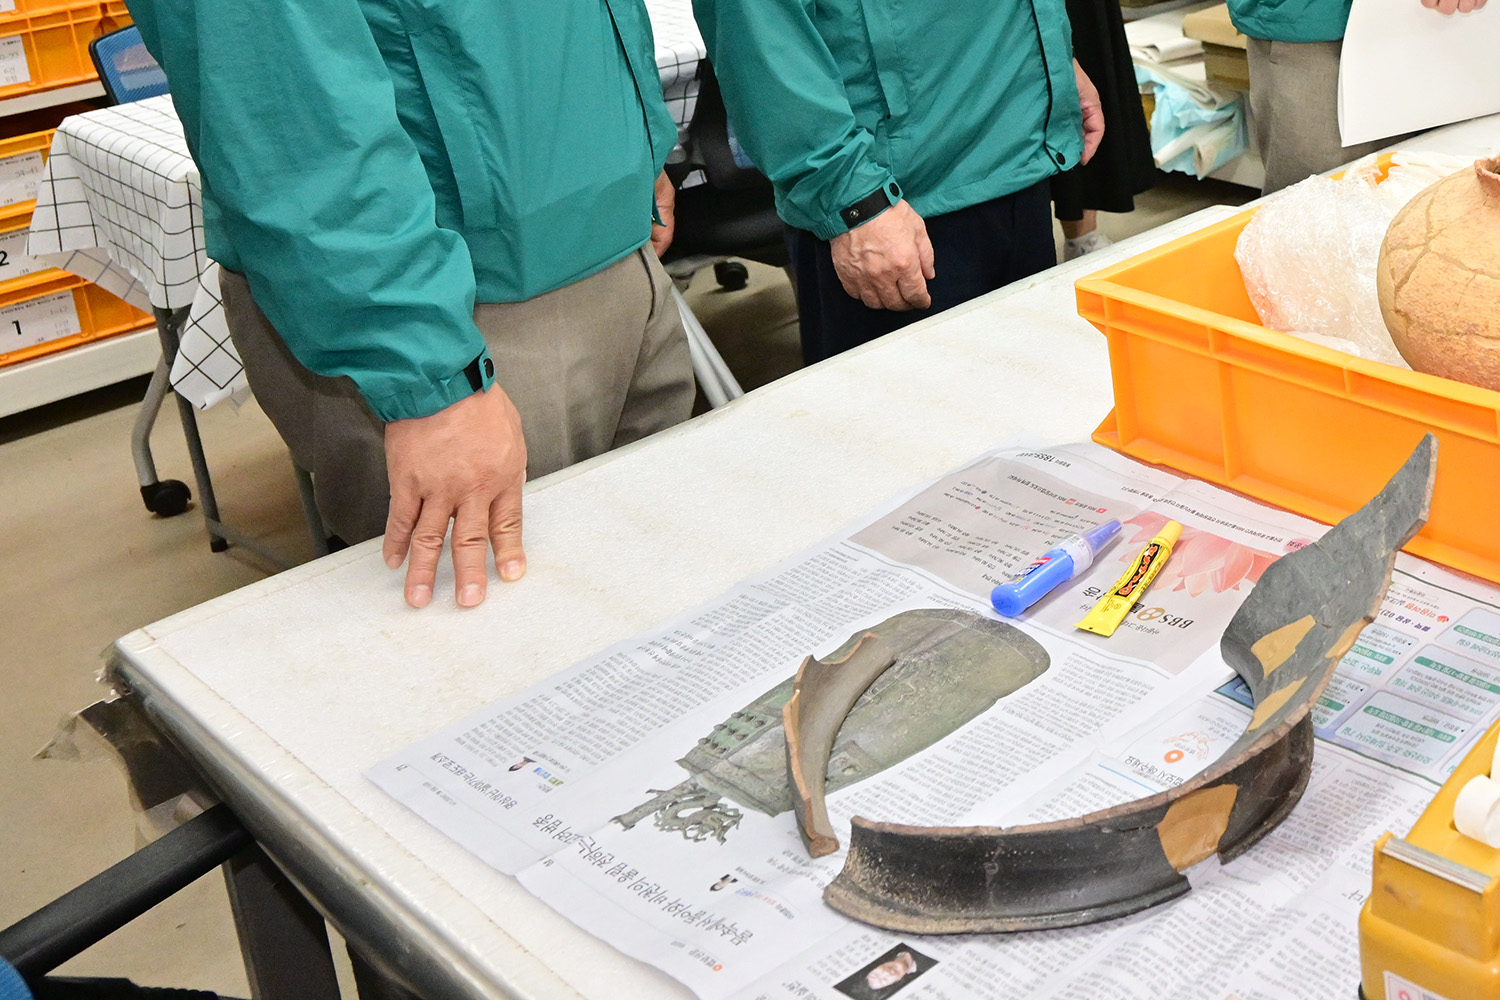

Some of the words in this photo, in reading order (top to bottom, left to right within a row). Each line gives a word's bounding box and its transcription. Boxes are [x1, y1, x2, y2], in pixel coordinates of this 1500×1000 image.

[0, 251, 10, 266] 2
[12, 320, 22, 334] 1
[1163, 612, 1194, 629] BBS
